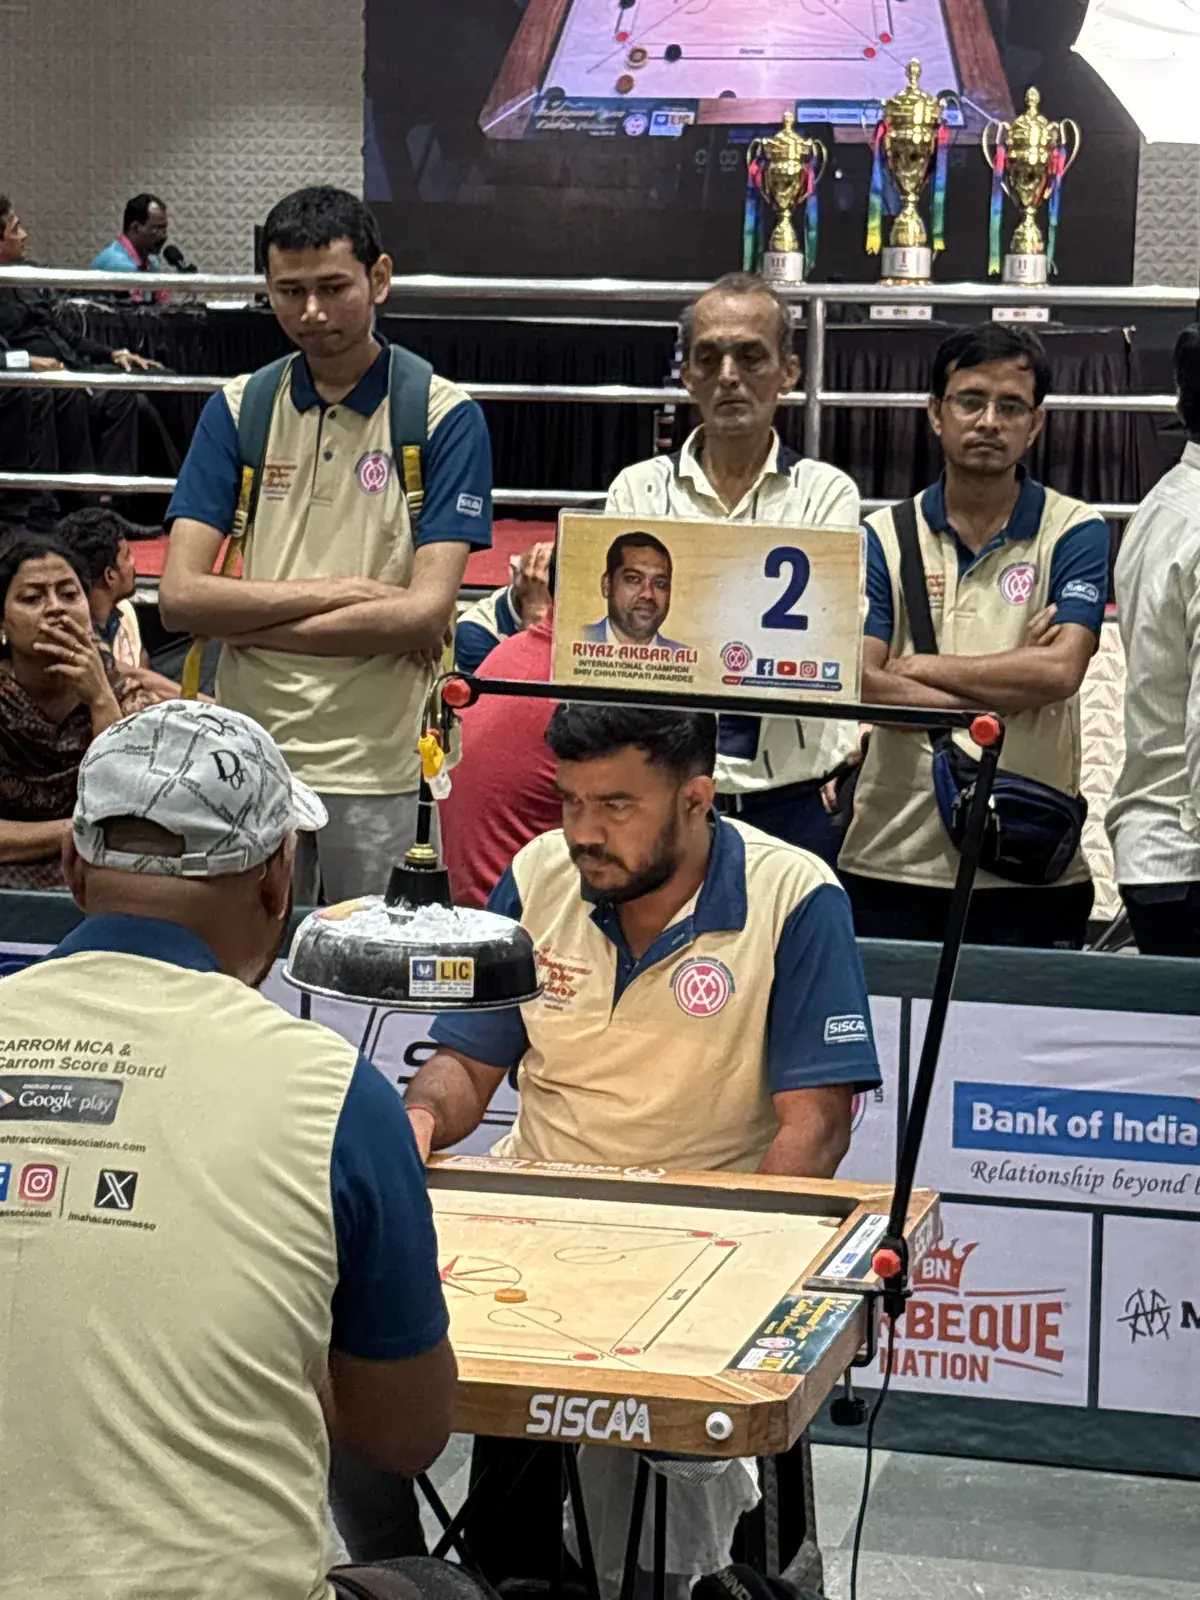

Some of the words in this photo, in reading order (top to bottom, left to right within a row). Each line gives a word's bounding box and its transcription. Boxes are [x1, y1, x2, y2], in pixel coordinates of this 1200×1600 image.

[761, 546, 810, 631] 2
[572, 643, 614, 658] RIYAZ
[618, 646, 670, 661] AKBAR
[675, 649, 698, 664] ALI
[573, 668, 592, 676] SHIV
[594, 669, 651, 680] CHHATRAPATI
[652, 673, 694, 683] AWARDEE
[578, 660, 642, 670] INTERNATIONAL
[645, 664, 689, 673] CHAMPION
[440, 961, 470, 980] LIC
[74, 1039, 115, 1055] MCA
[119, 1043, 132, 1057] &
[59, 1056, 109, 1073] Score
[112, 1060, 167, 1079] Board
[19, 1091, 77, 1113] Google
[79, 1095, 114, 1115] play
[971, 1101, 1058, 1137] Bank
[1067, 1110, 1104, 1140] of
[1113, 1111, 1198, 1147] India
[970, 1160, 1105, 1195] Relationship
[1112, 1168, 1192, 1197] beyond
[921, 1257, 951, 1281] BN
[877, 1301, 1065, 1363] BEQUE
[879, 1347, 990, 1383] NATION
[525, 1394, 651, 1443] SISCAA
